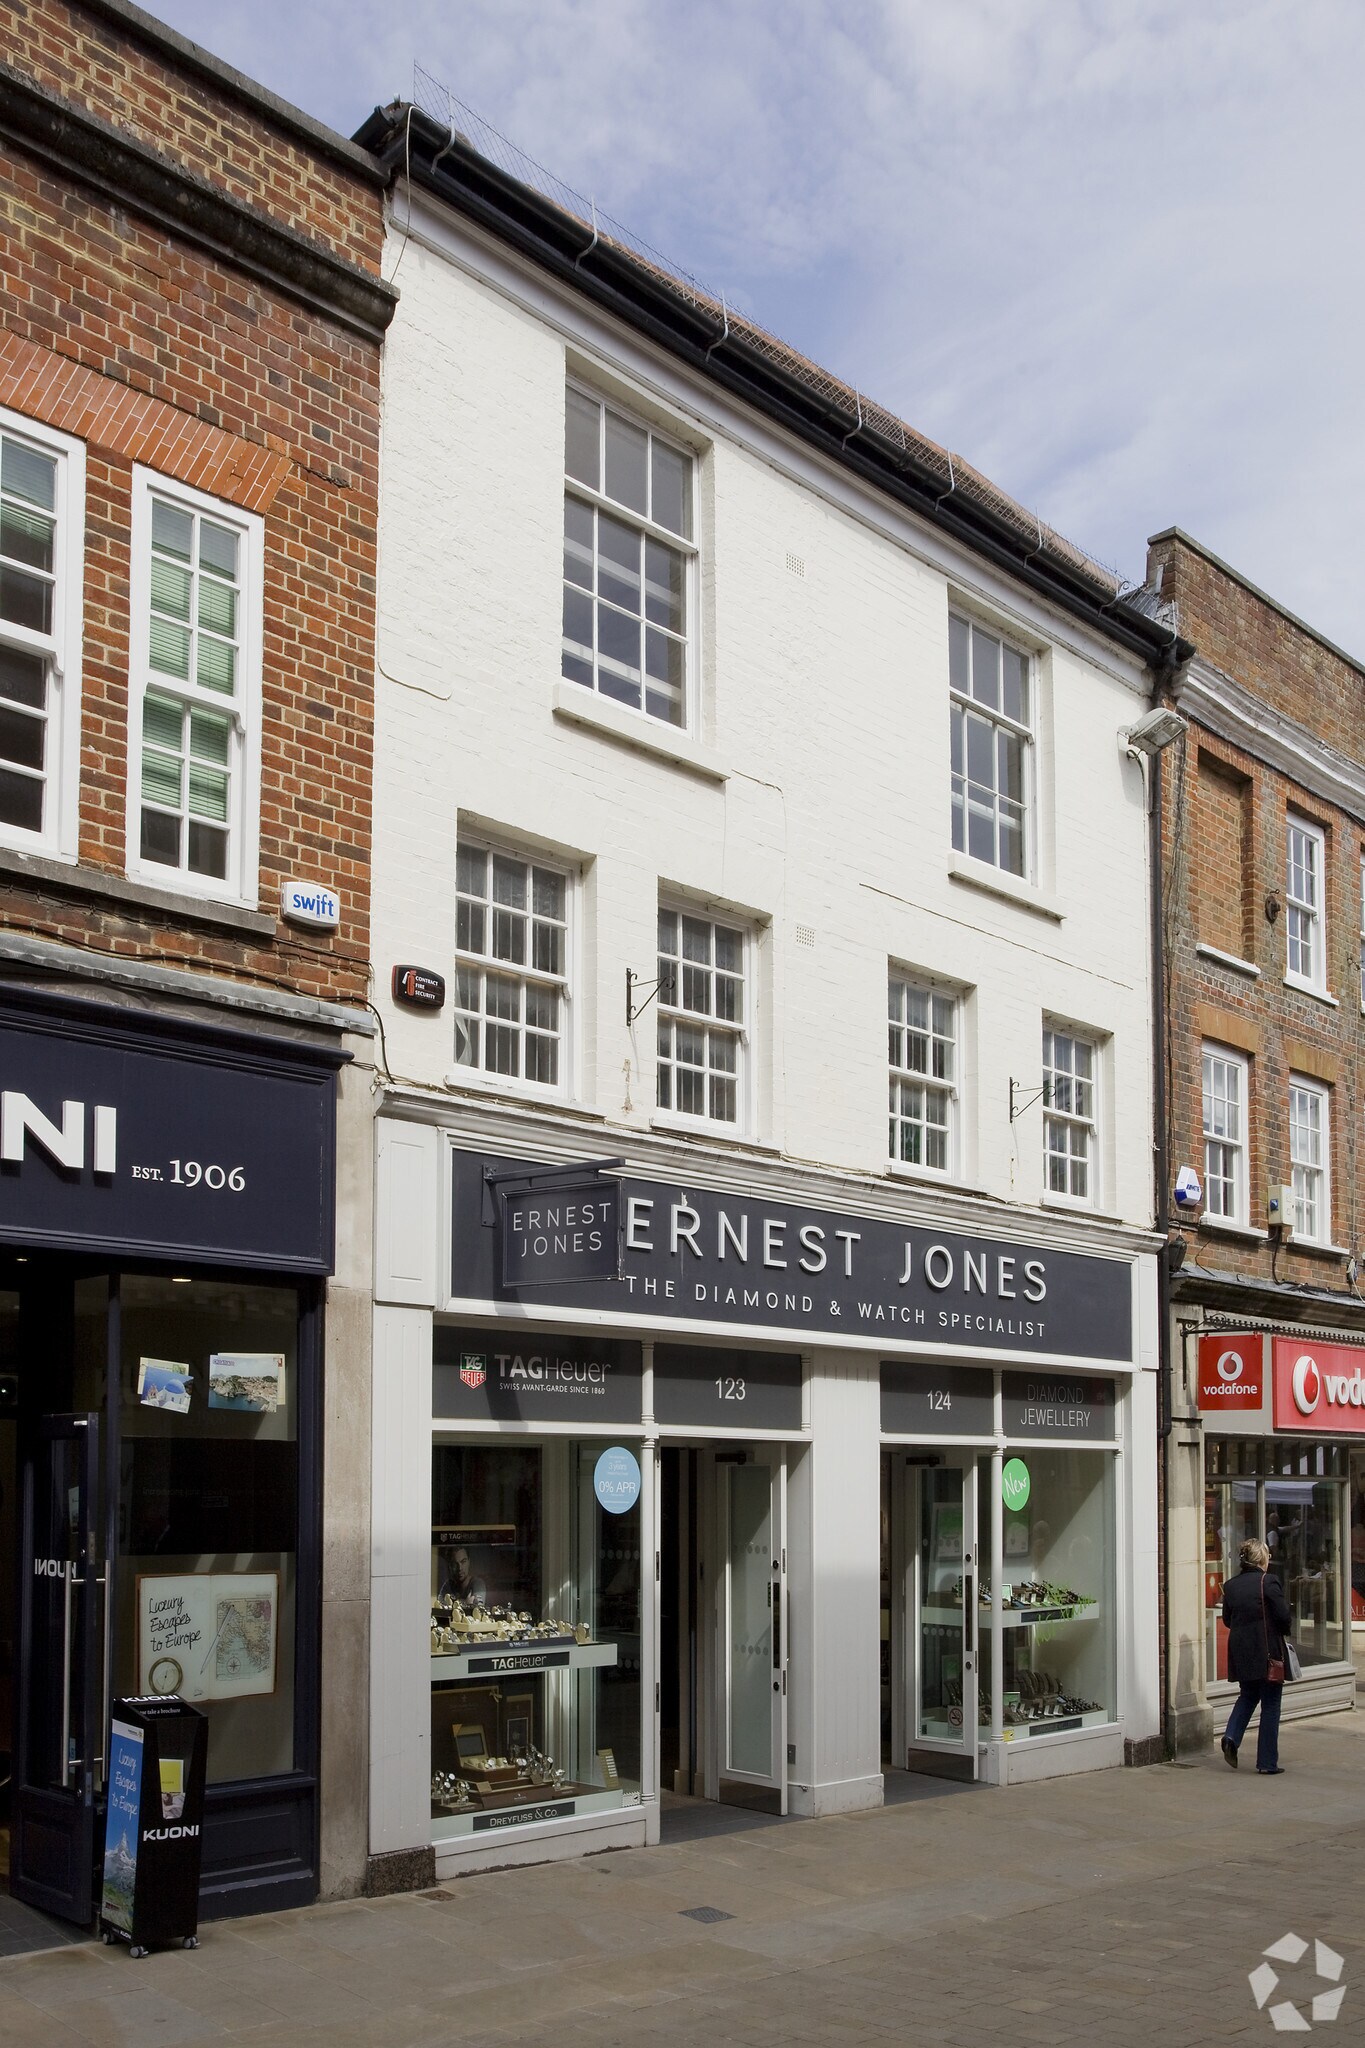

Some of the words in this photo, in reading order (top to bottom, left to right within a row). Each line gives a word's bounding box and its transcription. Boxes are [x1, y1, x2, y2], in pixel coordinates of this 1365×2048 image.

[292, 894, 334, 917] swift
[415, 976, 438, 986] CONTRACT
[415, 990, 435, 999] SECURITY
[1, 1090, 117, 1173] NI
[131, 1165, 164, 1182] EST.
[169, 1159, 246, 1192] 1906
[513, 1203, 611, 1232] ERNEST
[521, 1231, 602, 1257] JONES
[626, 1196, 861, 1276] ERNEST
[899, 1241, 1047, 1302] JONES
[626, 1275, 675, 1298] THE
[695, 1284, 813, 1312] DIAMOND
[829, 1301, 841, 1316] &
[858, 1302, 925, 1325] WATCH
[939, 1312, 1045, 1337] SPECIALIST
[464, 1355, 482, 1370] TAG
[462, 1370, 485, 1387] HEUER
[715, 1377, 746, 1400] 123
[522, 1384, 568, 1393] AVANT-GARDE
[570, 1385, 589, 1394] SINCE
[591, 1387, 605, 1395] 1860
[1028, 1384, 1084, 1404] DIAMOND
[1203, 1383, 1258, 1395] vodafone
[927, 1390, 952, 1411] 124
[1020, 1408, 1091, 1427] JEWELLERY
[599, 1481, 613, 1493] 0%
[616, 1481, 636, 1493] APR
[1004, 1472, 1027, 1498] New
[150, 1613, 191, 1634] Escapes
[150, 1637, 163, 1652] to
[165, 1630, 201, 1650] Europe
[121, 1694, 180, 1703] KUONI
[534, 1808, 543, 1819] &
[143, 1824, 200, 1842] KUONI
